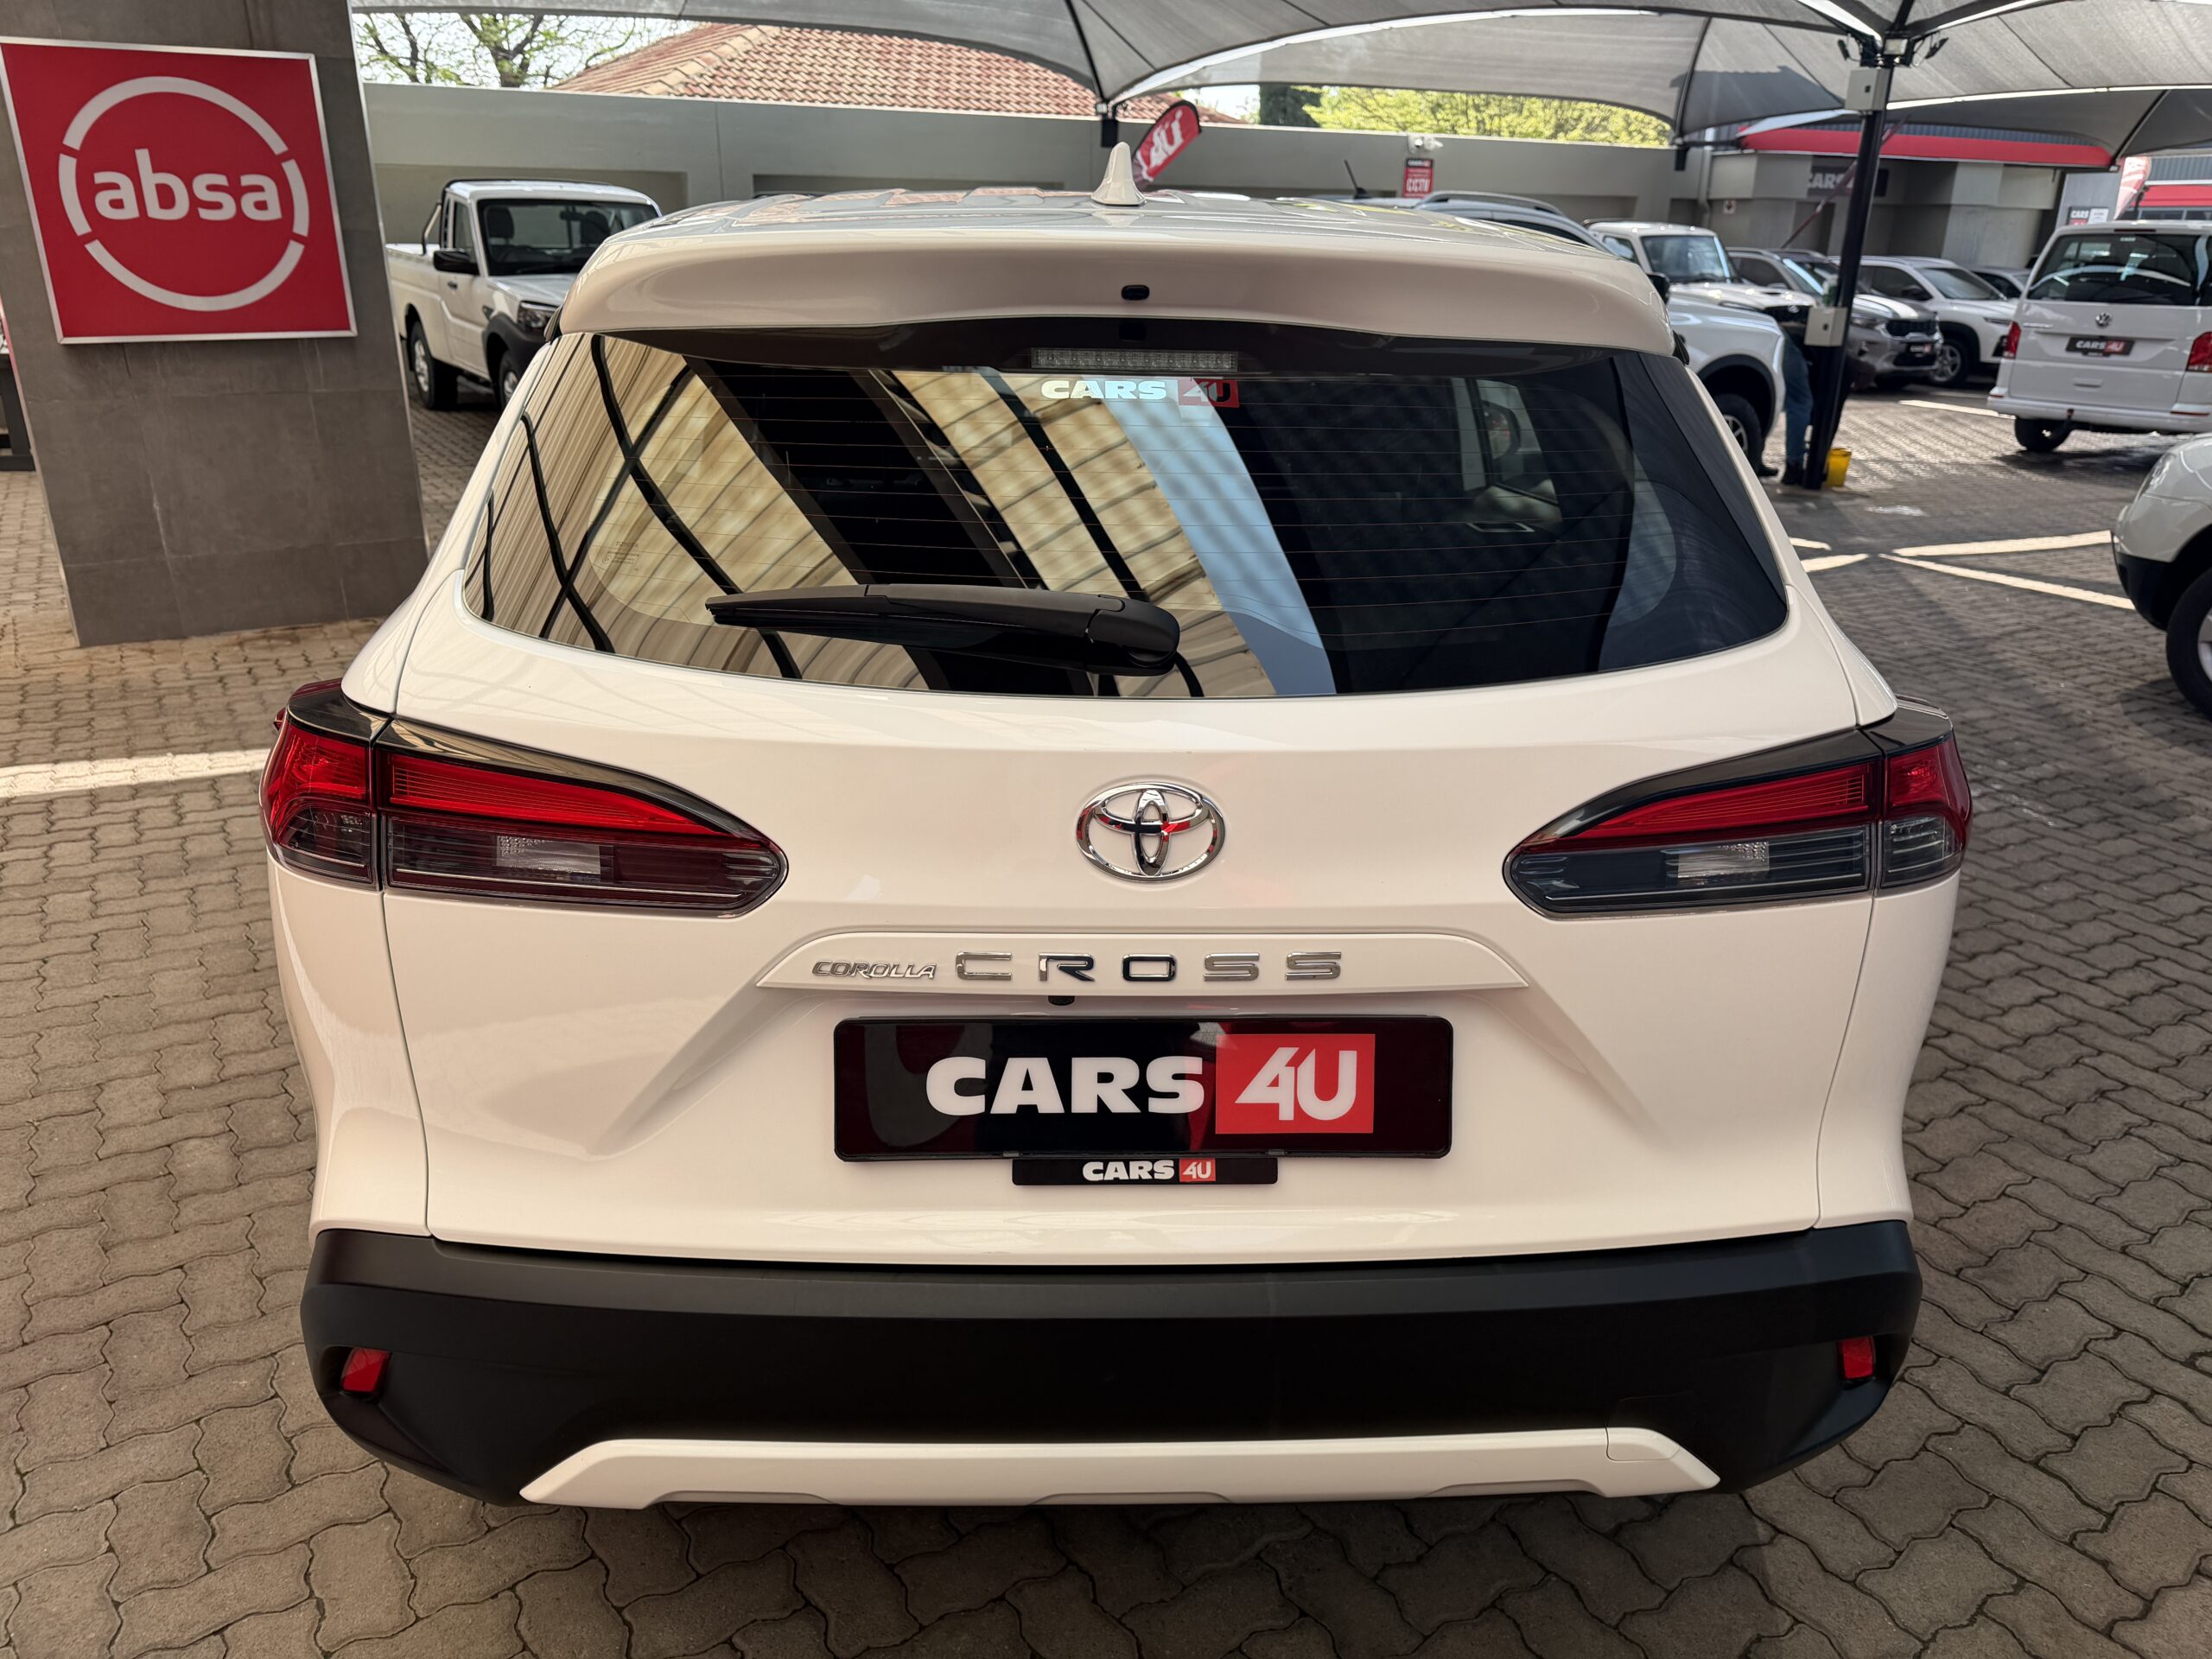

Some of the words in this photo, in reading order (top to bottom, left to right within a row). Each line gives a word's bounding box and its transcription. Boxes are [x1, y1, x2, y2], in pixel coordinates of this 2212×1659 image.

[93, 148, 283, 221] absa
[2075, 340, 2105, 349] CARS
[1041, 380, 1166, 400] CARS
[1183, 382, 1231, 403] 4U
[812, 960, 937, 979] COROLLA
[956, 951, 1342, 982] CROSS
[926, 1056, 1205, 1116] CARS
[1235, 1047, 1357, 1121] 4U
[1083, 1160, 1175, 1181] CARS
[1182, 1161, 1211, 1179] 4U
